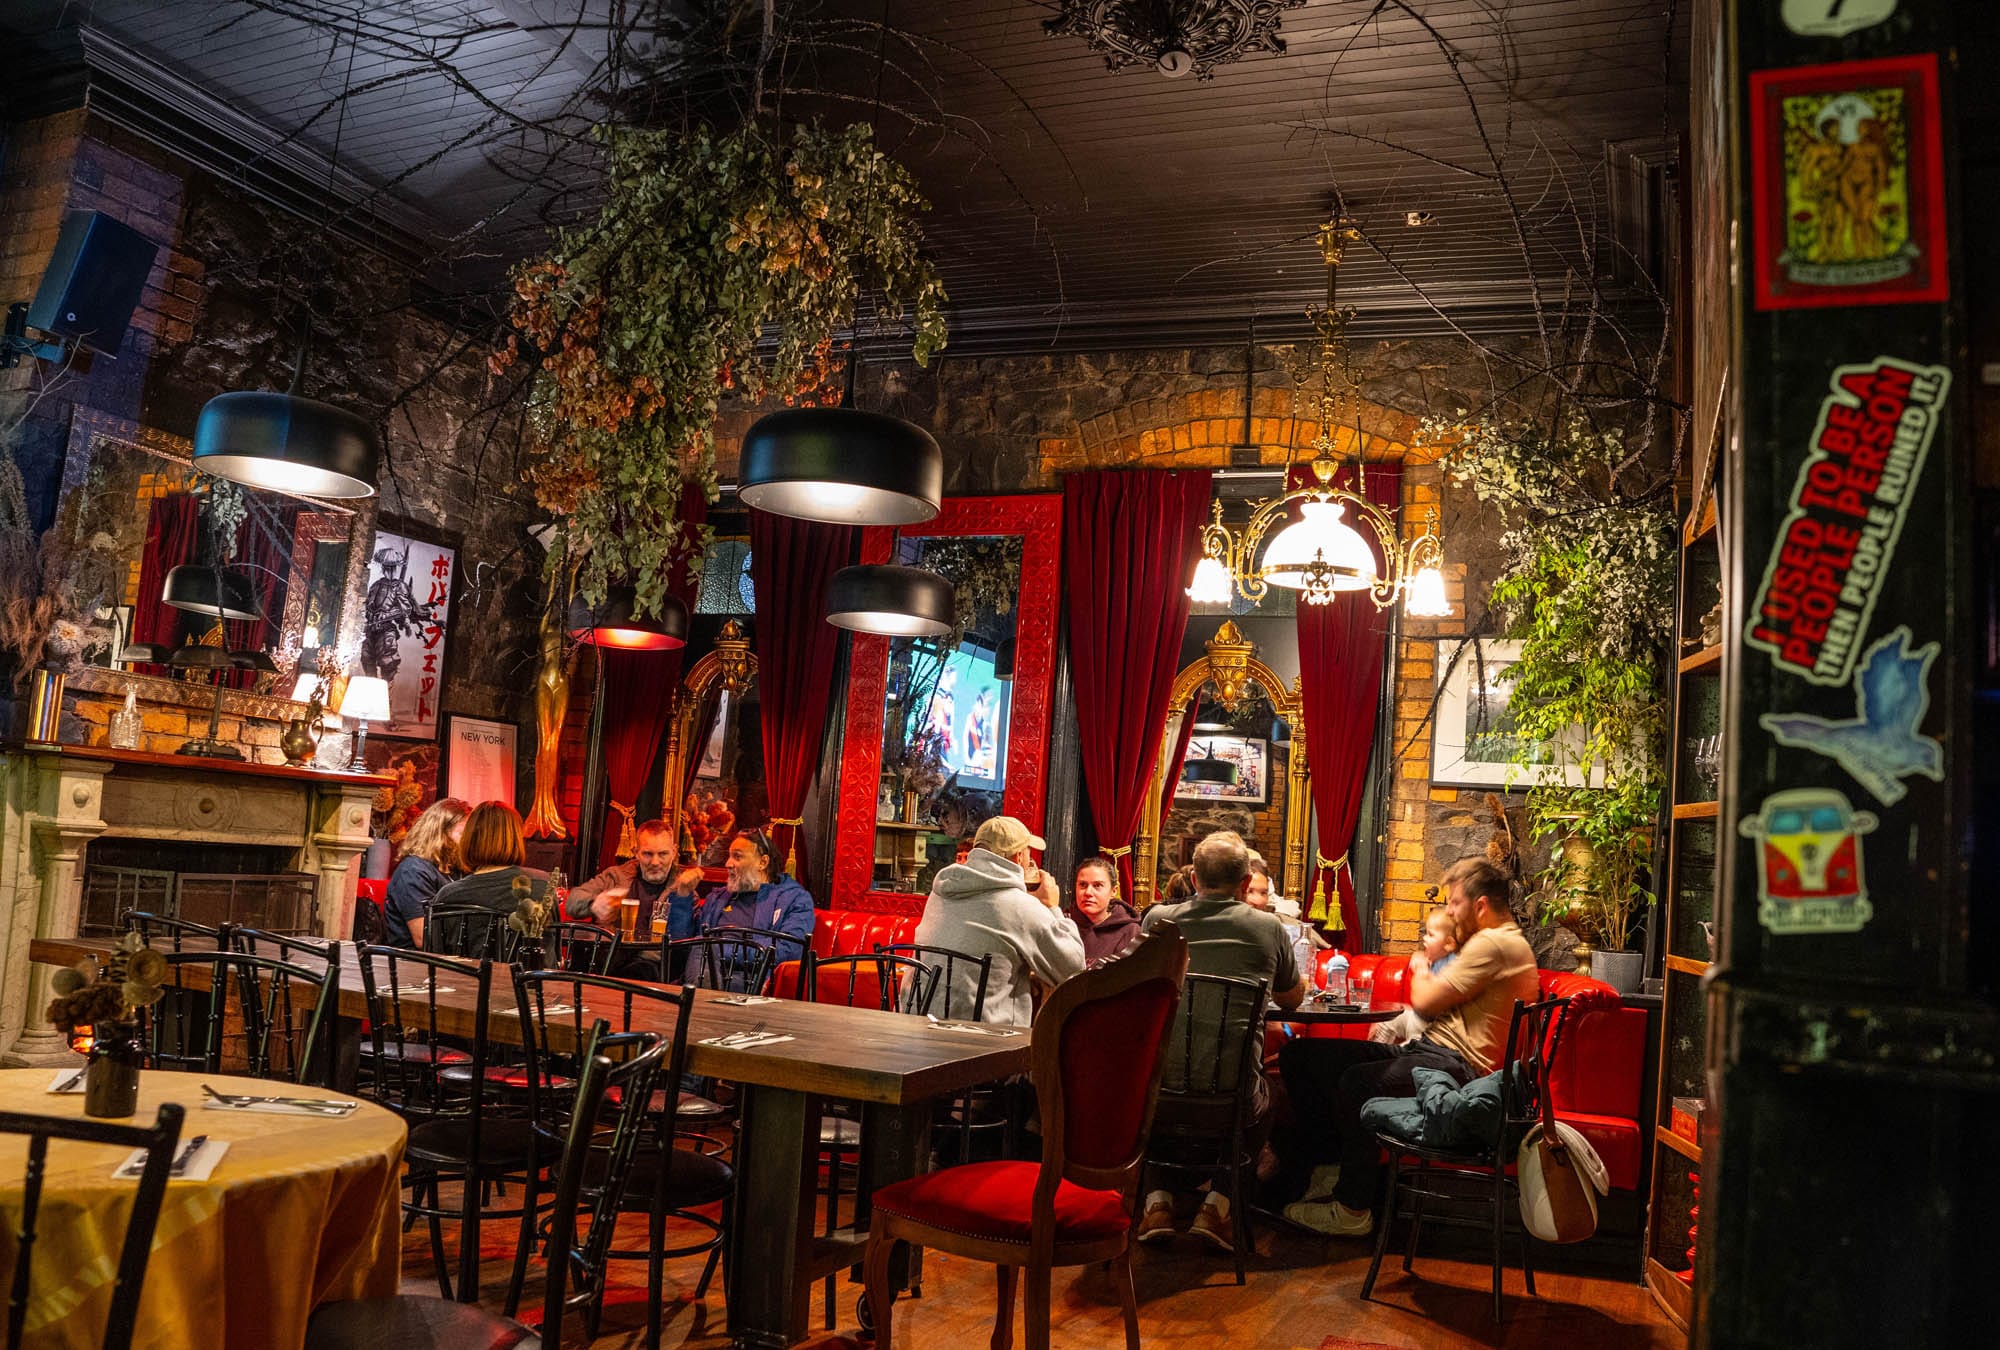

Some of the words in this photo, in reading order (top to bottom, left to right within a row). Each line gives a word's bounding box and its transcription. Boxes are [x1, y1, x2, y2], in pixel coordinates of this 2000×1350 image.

[1840, 374, 1878, 399] A
[1820, 404, 1866, 455] BE
[1799, 462, 1844, 508] TO
[1781, 523, 1862, 668] PEOPLE
[1836, 366, 1915, 518] PERSON
[1814, 608, 1860, 675] THEN
[1840, 505, 1896, 606] PEOPLE
[1876, 406, 1928, 504] RUINED
[1761, 518, 1824, 620] USED
[1752, 625, 1787, 645] I
[461, 732, 480, 742] NEW
[483, 734, 506, 746] YORK
